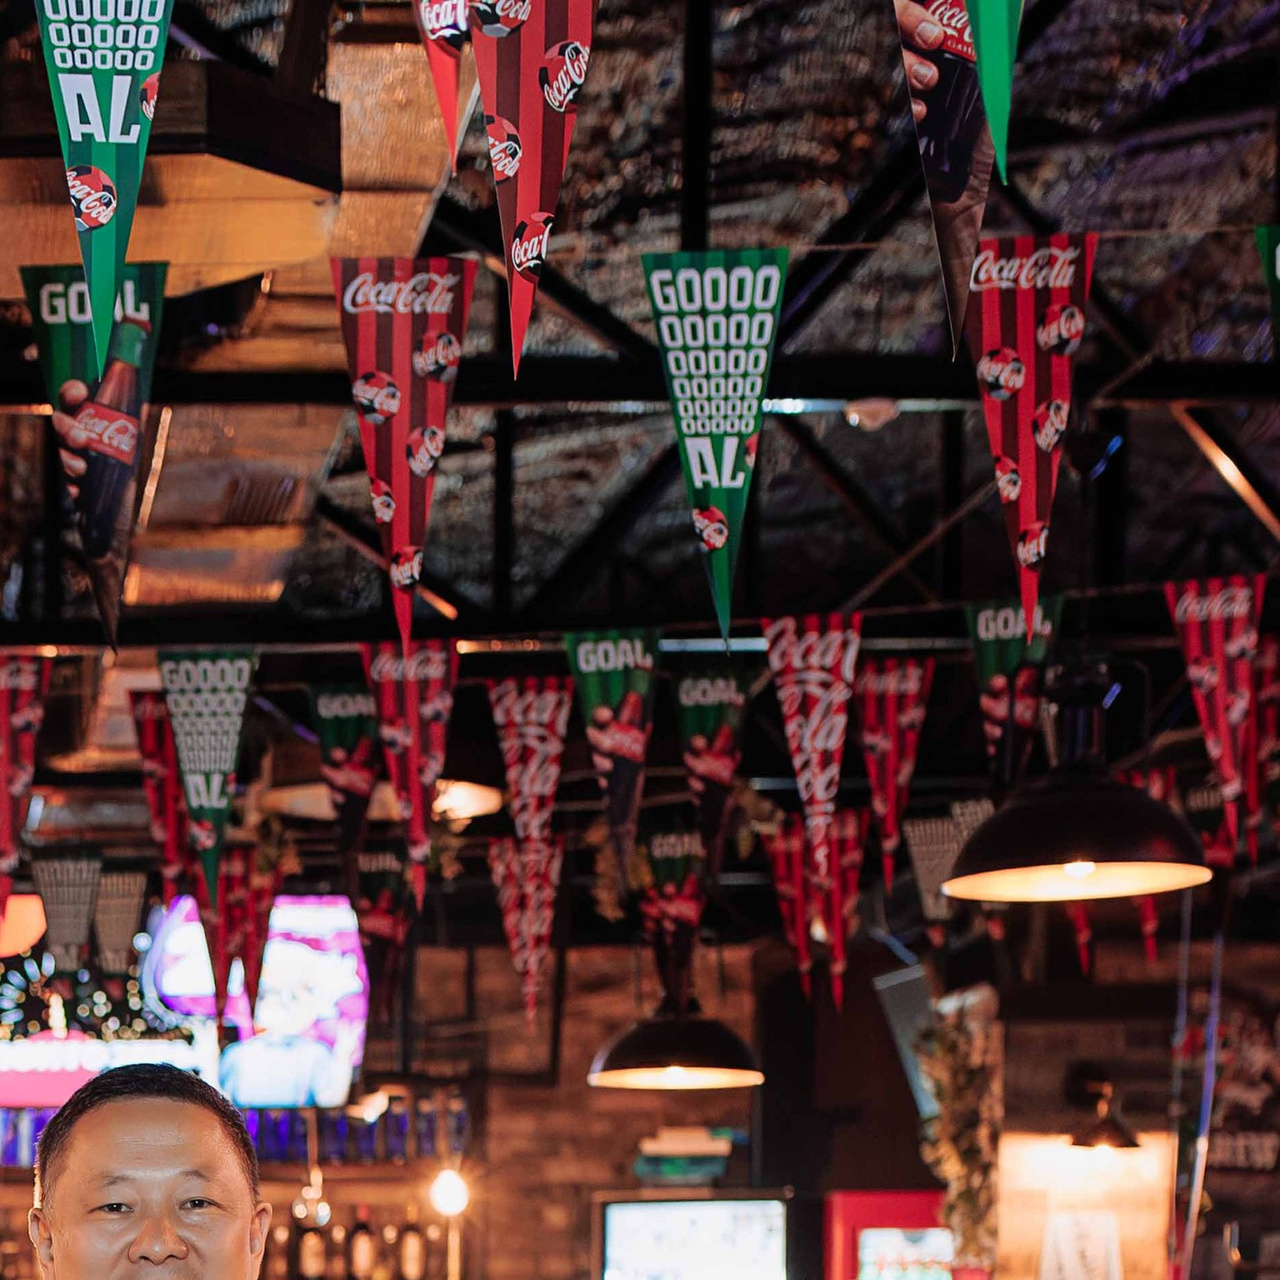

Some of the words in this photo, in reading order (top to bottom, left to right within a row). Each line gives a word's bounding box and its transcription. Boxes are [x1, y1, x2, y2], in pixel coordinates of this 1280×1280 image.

[58, 73, 141, 144] AL
[650, 264, 782, 313] GOOOO
[684, 436, 746, 490] AL
[576, 637, 654, 673] GOAL
